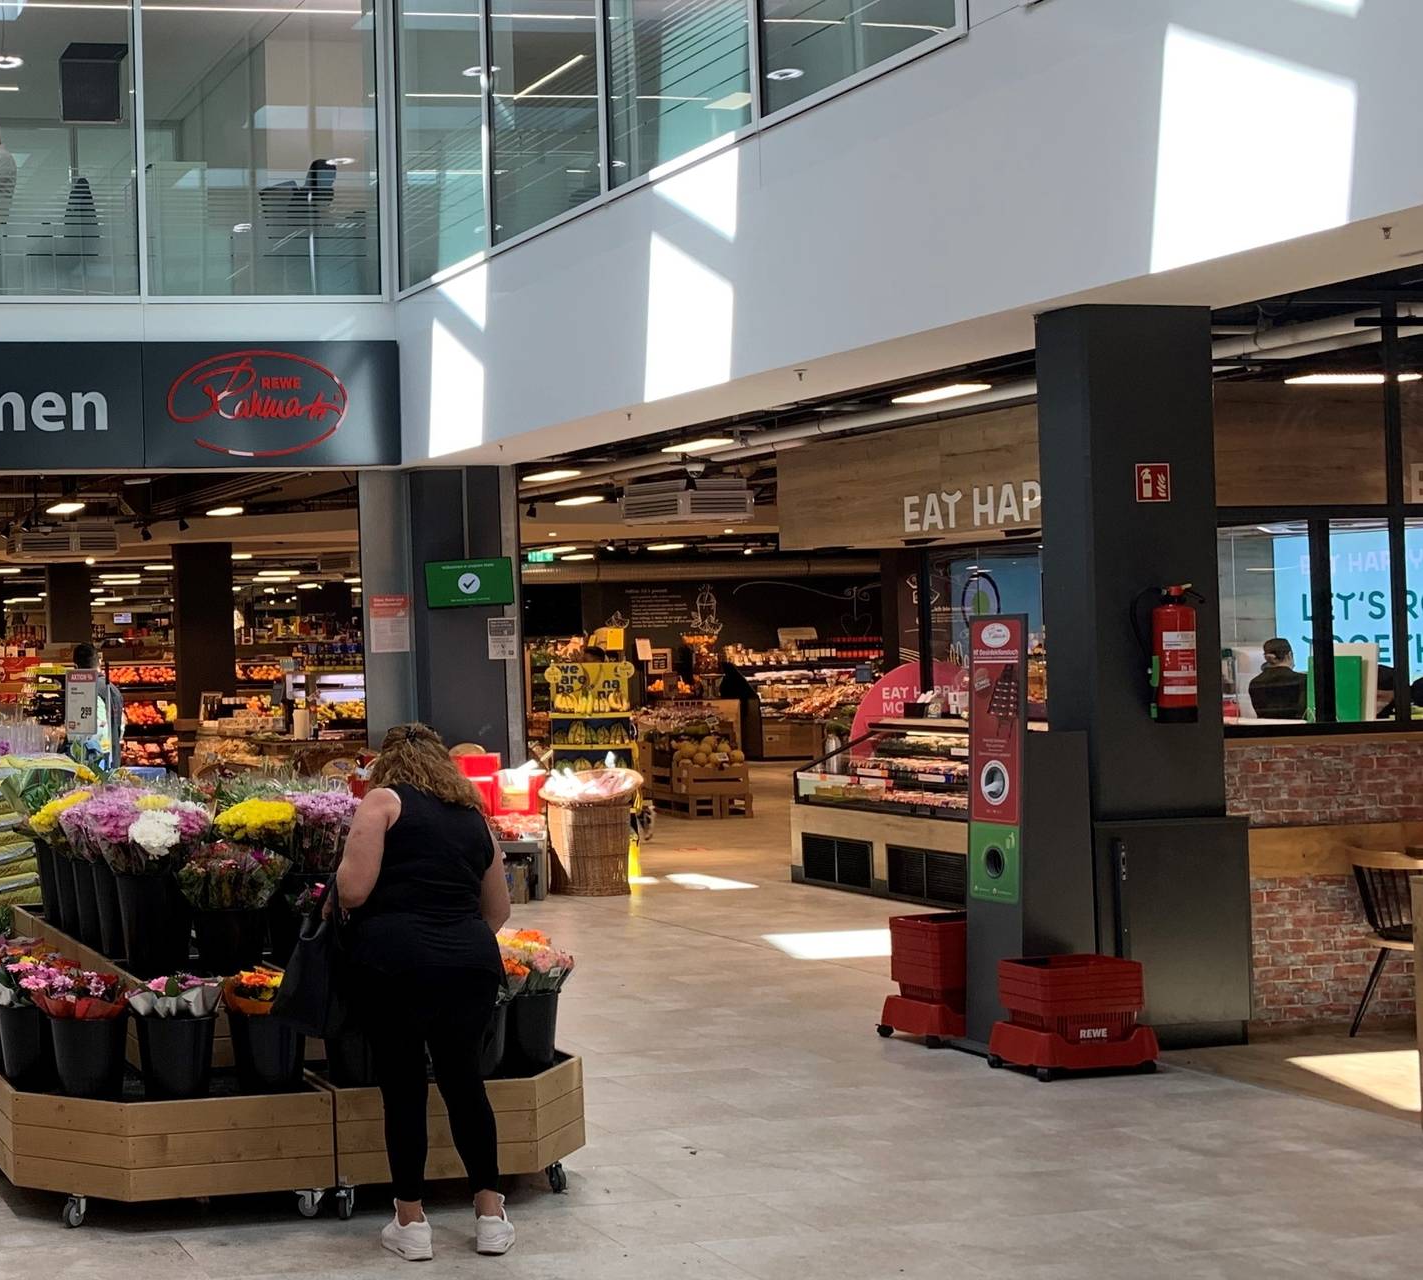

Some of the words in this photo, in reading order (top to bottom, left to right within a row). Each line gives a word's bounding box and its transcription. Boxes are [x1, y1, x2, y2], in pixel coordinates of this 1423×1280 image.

[260, 376, 301, 390] REWE
[903, 490, 962, 532] EAT
[602, 680, 620, 689] na
[882, 686, 909, 699] EAT
[1079, 1028, 1107, 1039] REWE
